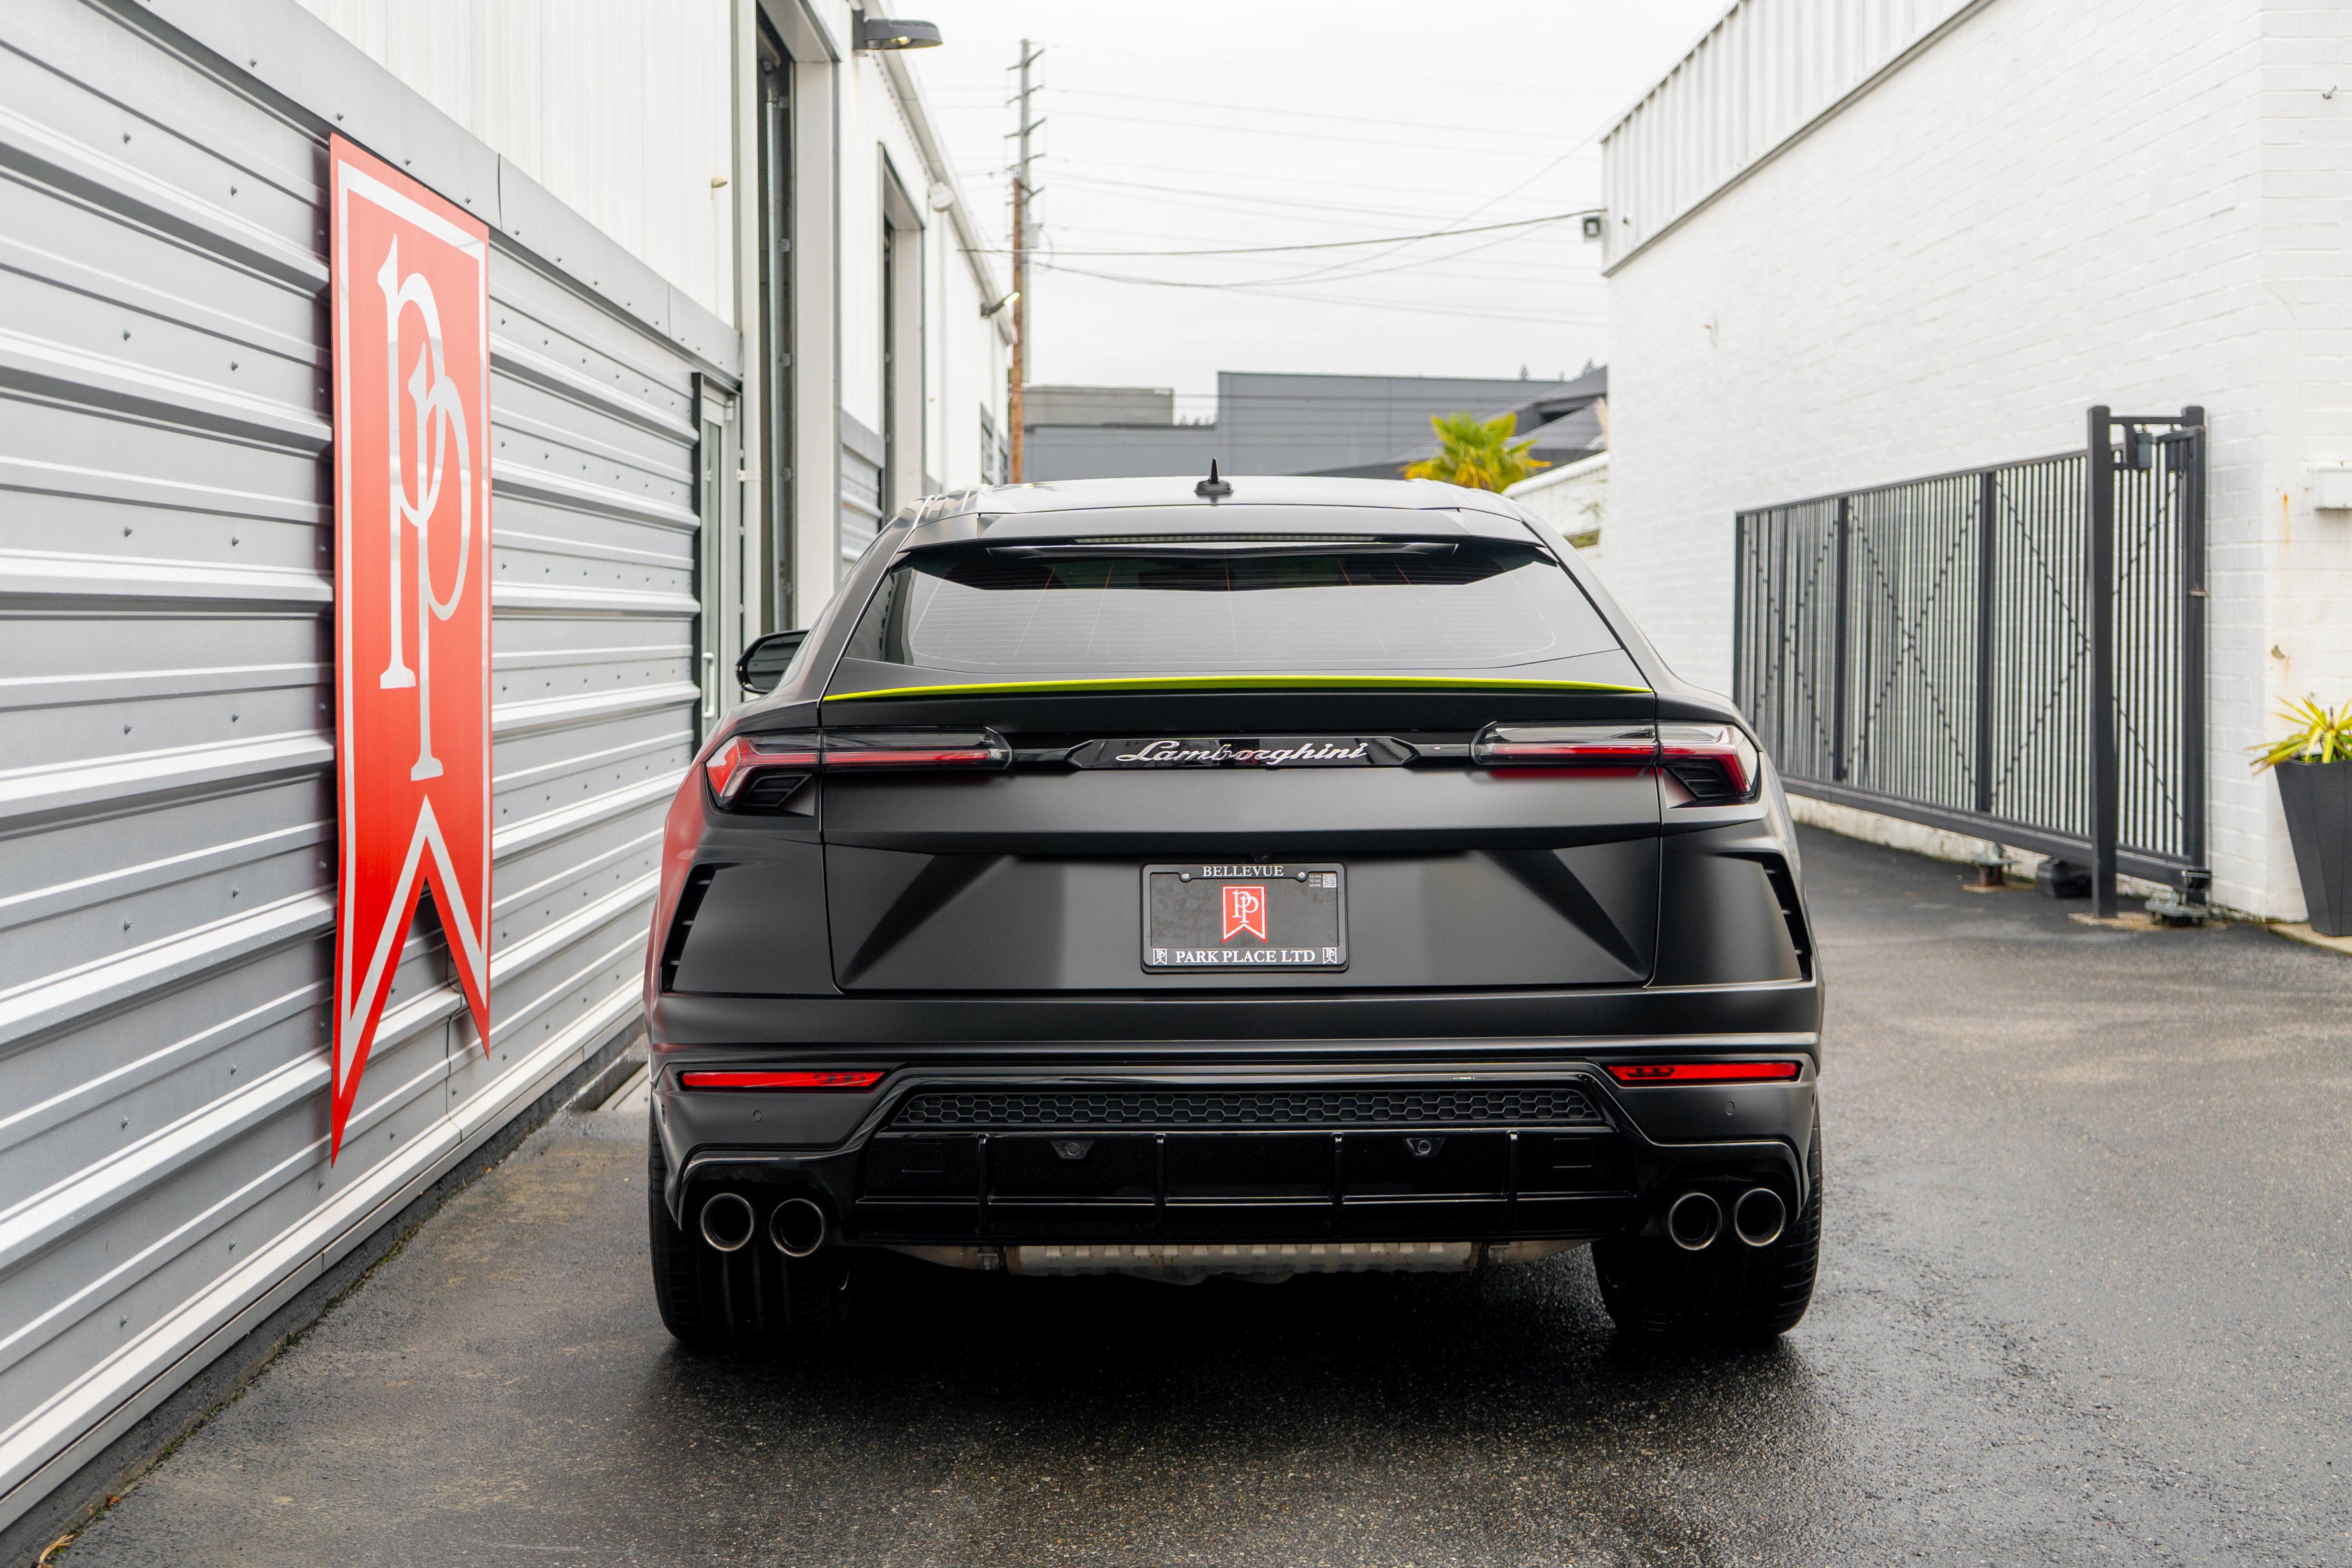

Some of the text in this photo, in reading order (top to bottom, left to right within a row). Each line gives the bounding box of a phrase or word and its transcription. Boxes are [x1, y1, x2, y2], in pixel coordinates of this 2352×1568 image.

[1116, 739, 1368, 764] Lamborghini
[1202, 865, 1284, 877] BELLEVUE
[1175, 950, 1316, 963] PARK PLACE LTD
